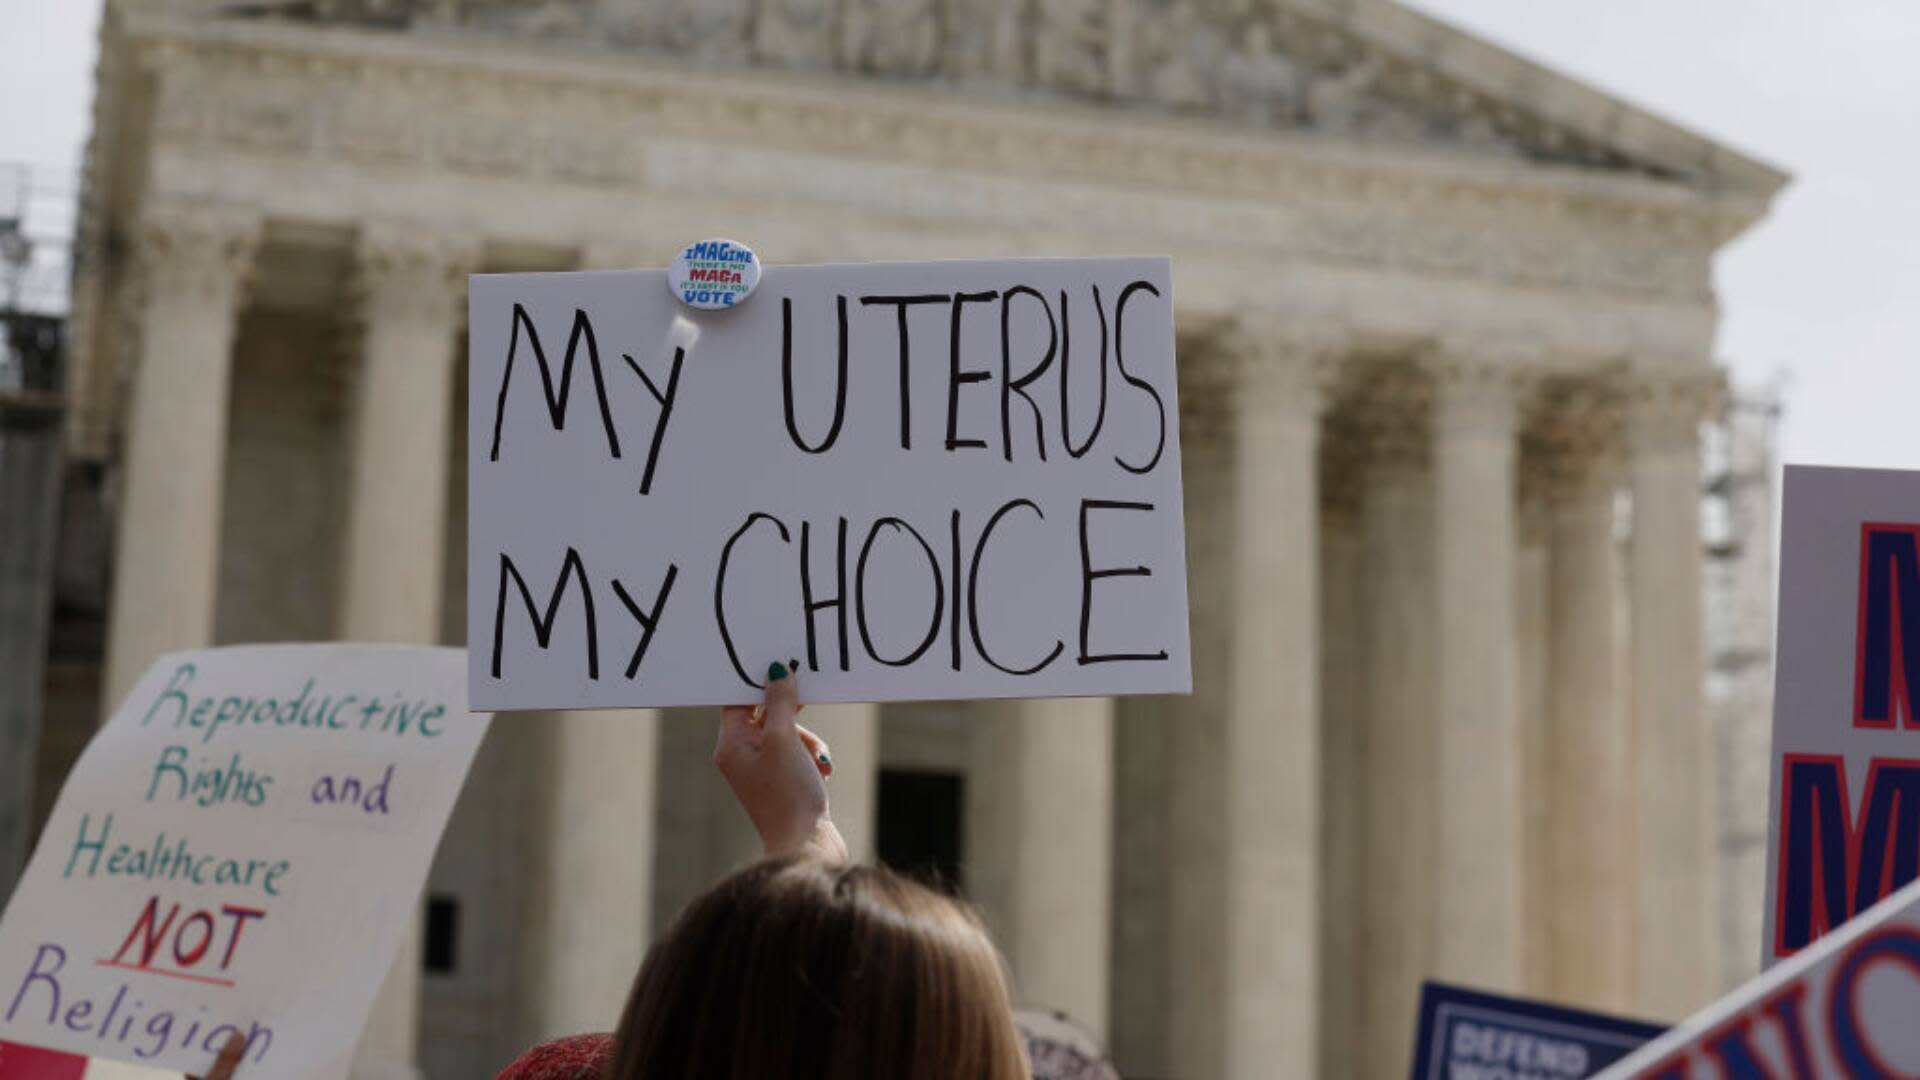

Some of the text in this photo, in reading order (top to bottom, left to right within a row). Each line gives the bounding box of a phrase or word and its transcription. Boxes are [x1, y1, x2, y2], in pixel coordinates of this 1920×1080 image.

[684, 290, 735, 305] VOTE
[729, 263, 746, 271] NO
[730, 283, 750, 293] YOU
[782, 281, 1165, 474] UTERUS
[715, 499, 1168, 690] CHOICE
[141, 663, 447, 743] Reproductive
[146, 746, 395, 813] Rights and
[63, 814, 291, 896] Healthcare
[110, 896, 267, 970] NOT
[5, 943, 274, 1064] Religion
[1453, 1023, 1586, 1073] DEFEND
